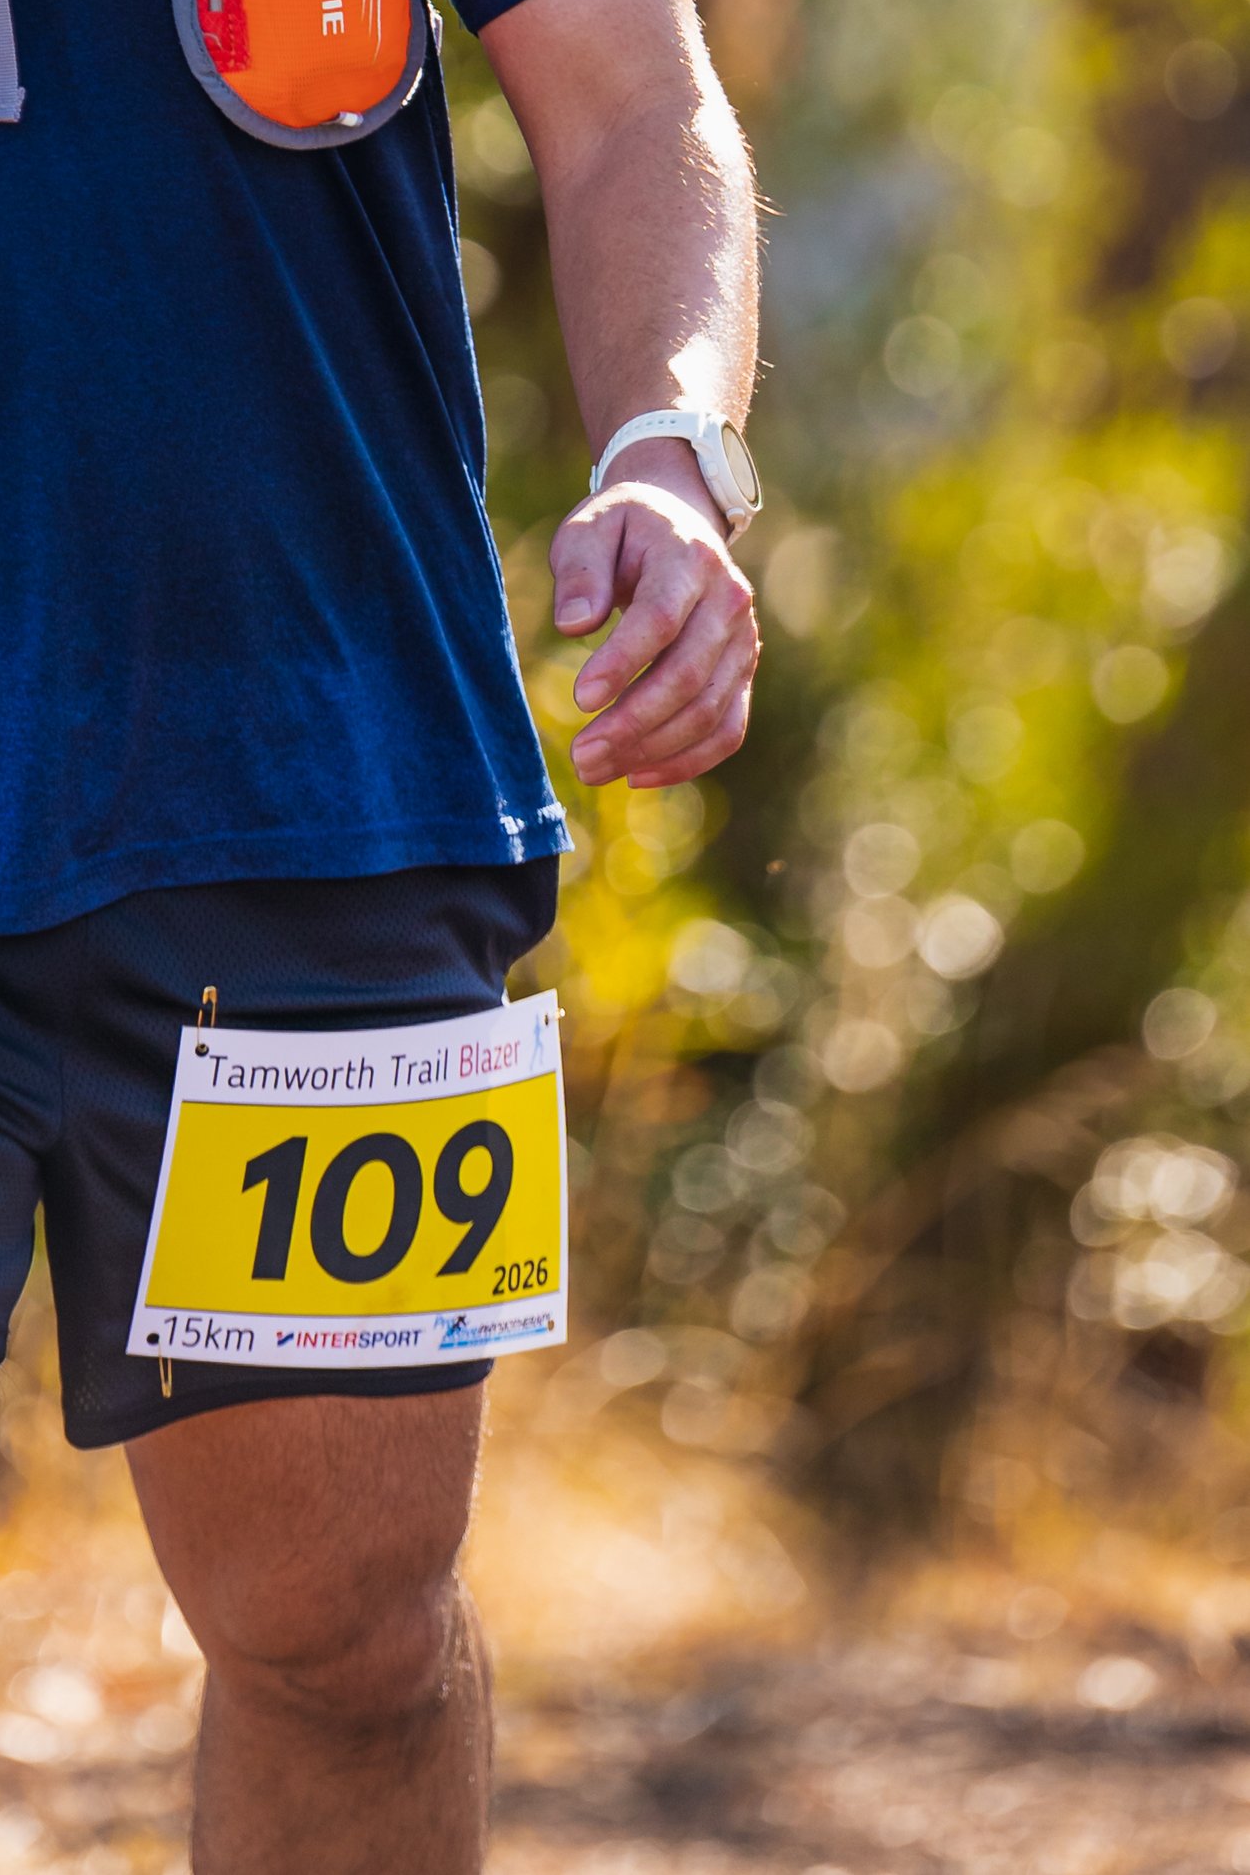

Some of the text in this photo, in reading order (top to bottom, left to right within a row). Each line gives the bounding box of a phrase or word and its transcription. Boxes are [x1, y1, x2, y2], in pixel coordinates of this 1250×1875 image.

[209, 1039, 521, 1091] Tamworth Trail Blazer
[241, 1119, 514, 1285] 109
[492, 1256, 549, 1296] 2026
[163, 1315, 255, 1352] 15km
[295, 1329, 423, 1349] INTERSPORT
